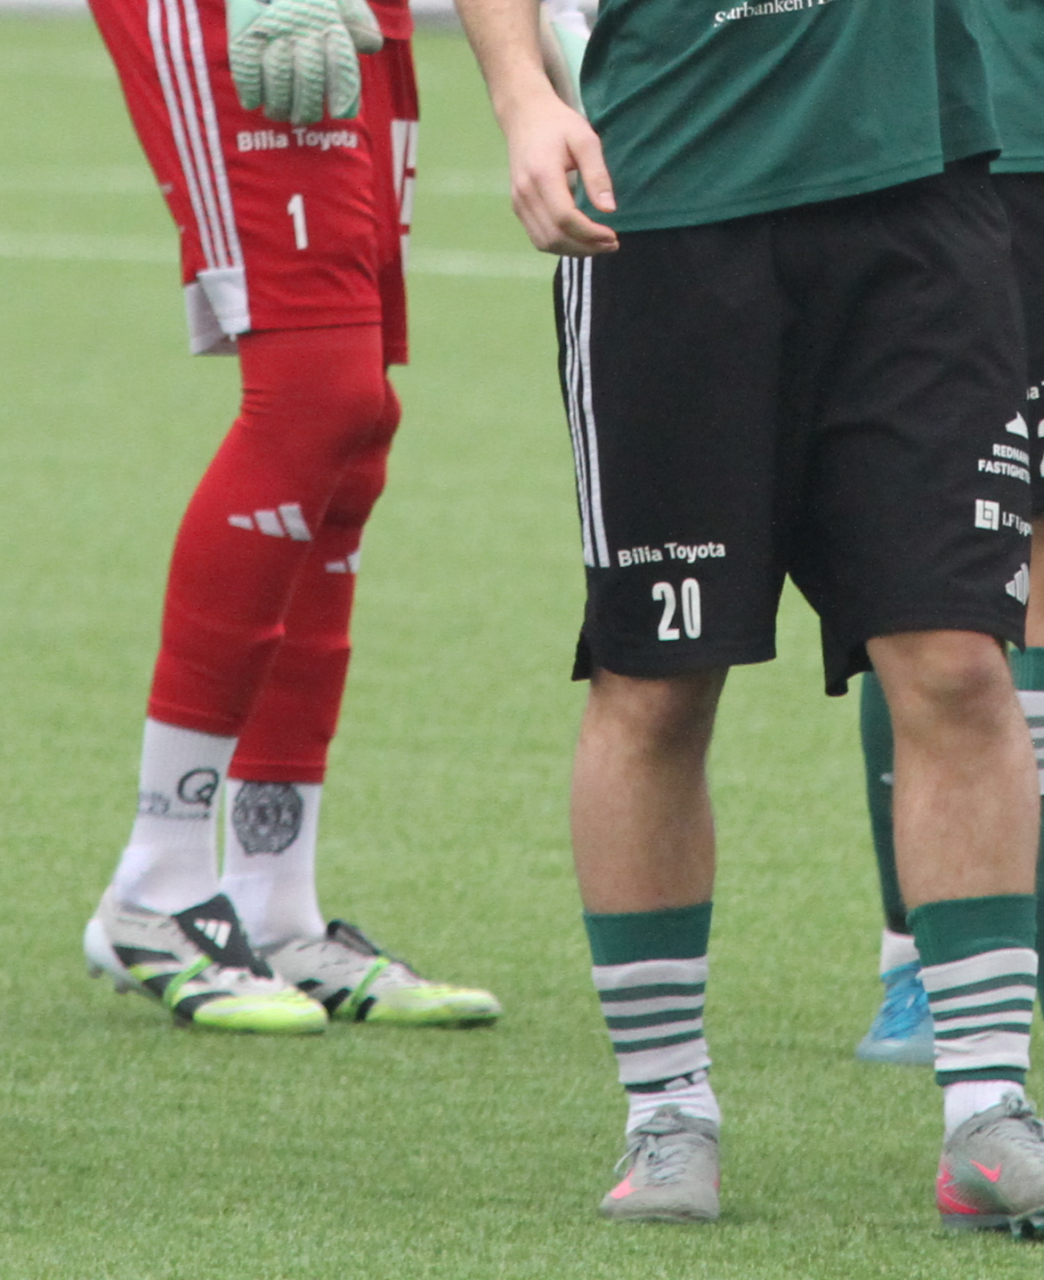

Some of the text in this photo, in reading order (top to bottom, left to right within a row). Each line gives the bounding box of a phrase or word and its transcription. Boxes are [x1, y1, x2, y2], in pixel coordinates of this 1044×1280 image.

[286, 192, 309, 251] 1
[617, 541, 726, 568] Bilia Toyota
[651, 576, 702, 642] 20
